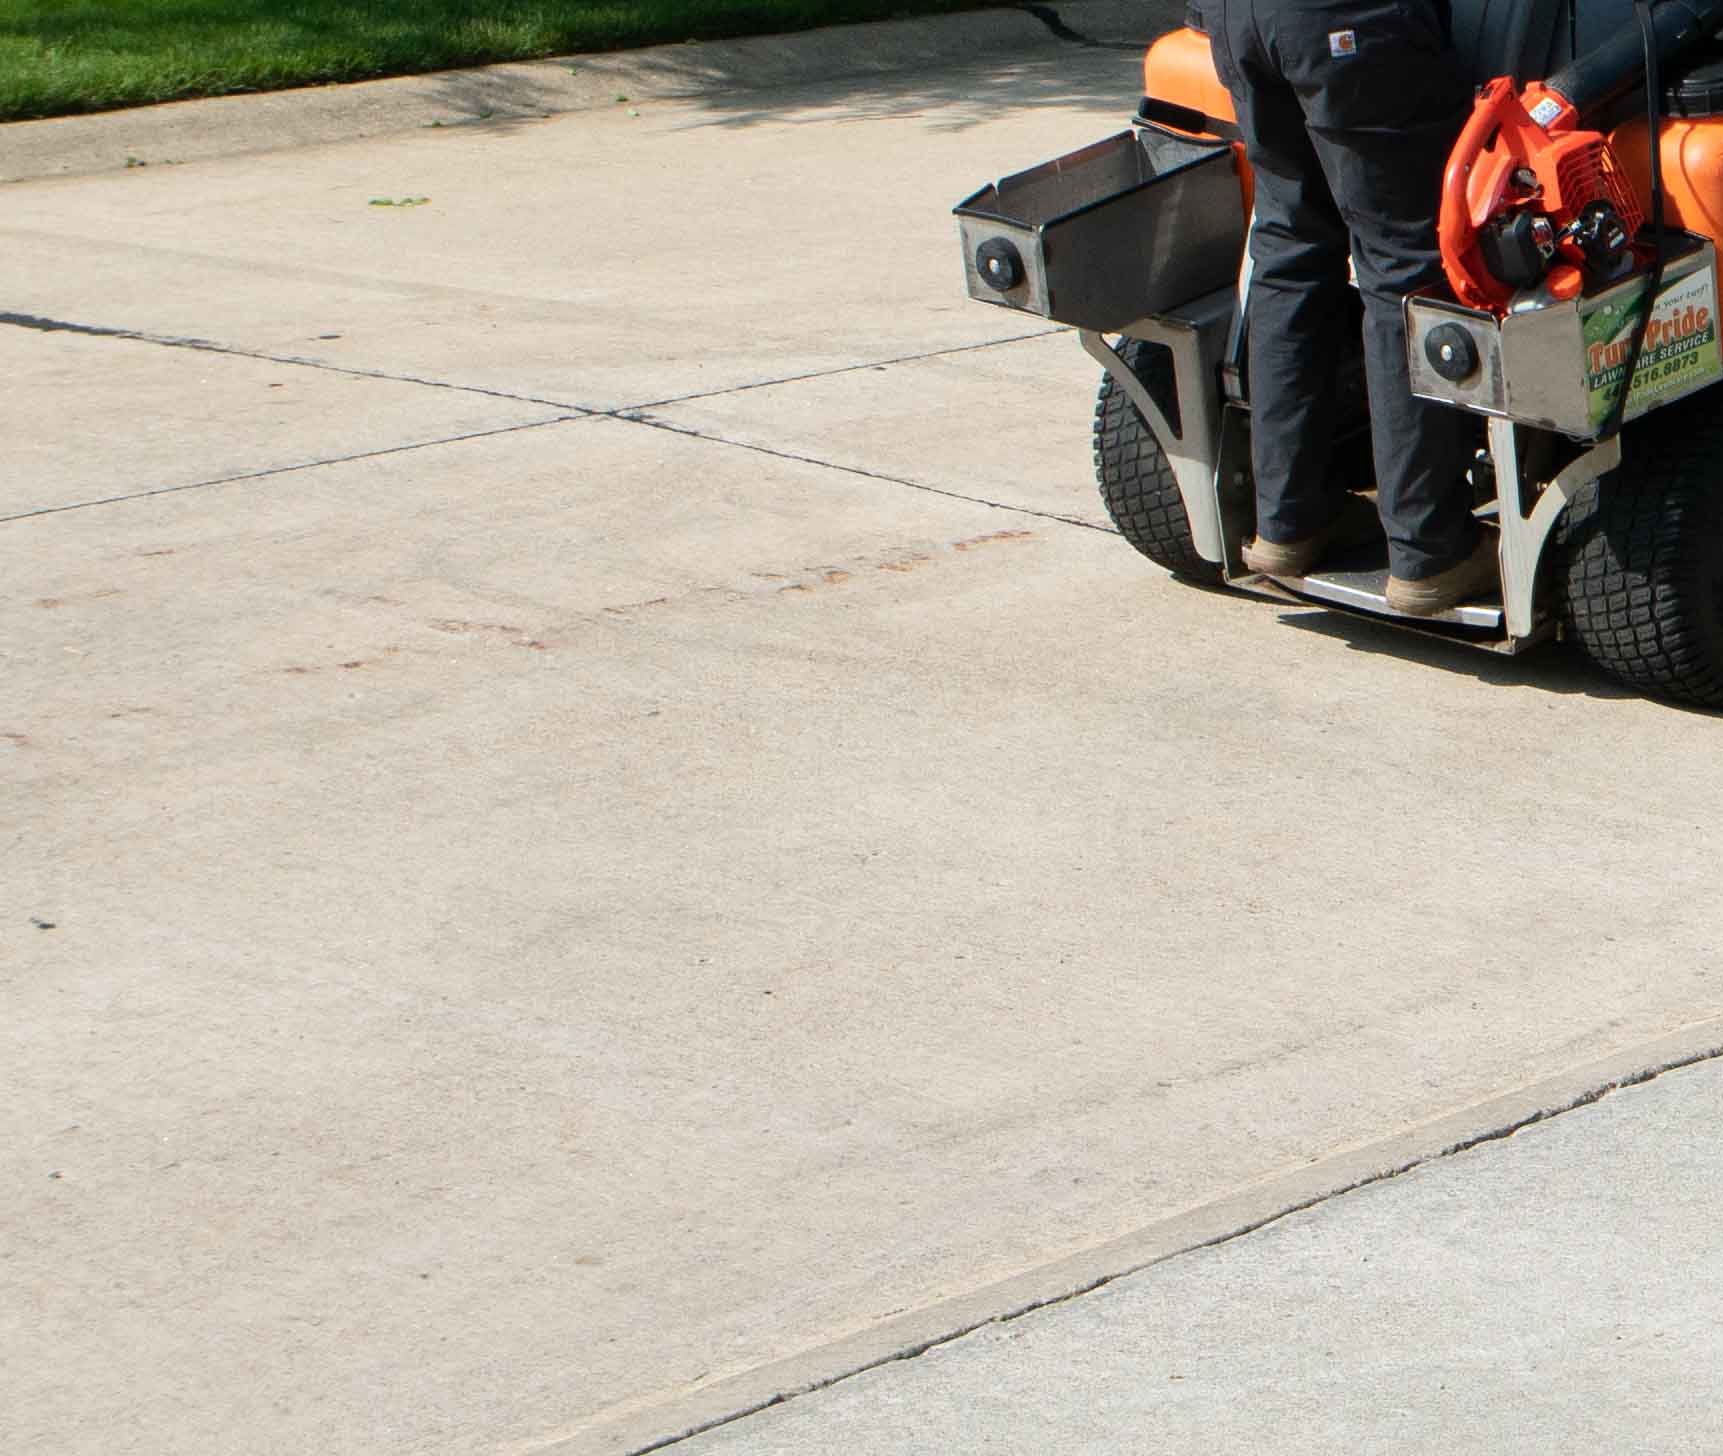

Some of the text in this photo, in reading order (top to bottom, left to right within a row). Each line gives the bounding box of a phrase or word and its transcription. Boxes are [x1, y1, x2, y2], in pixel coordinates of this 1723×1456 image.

[1588, 304, 1710, 374] Tur Pride
[1659, 332, 1709, 360] SERVICE
